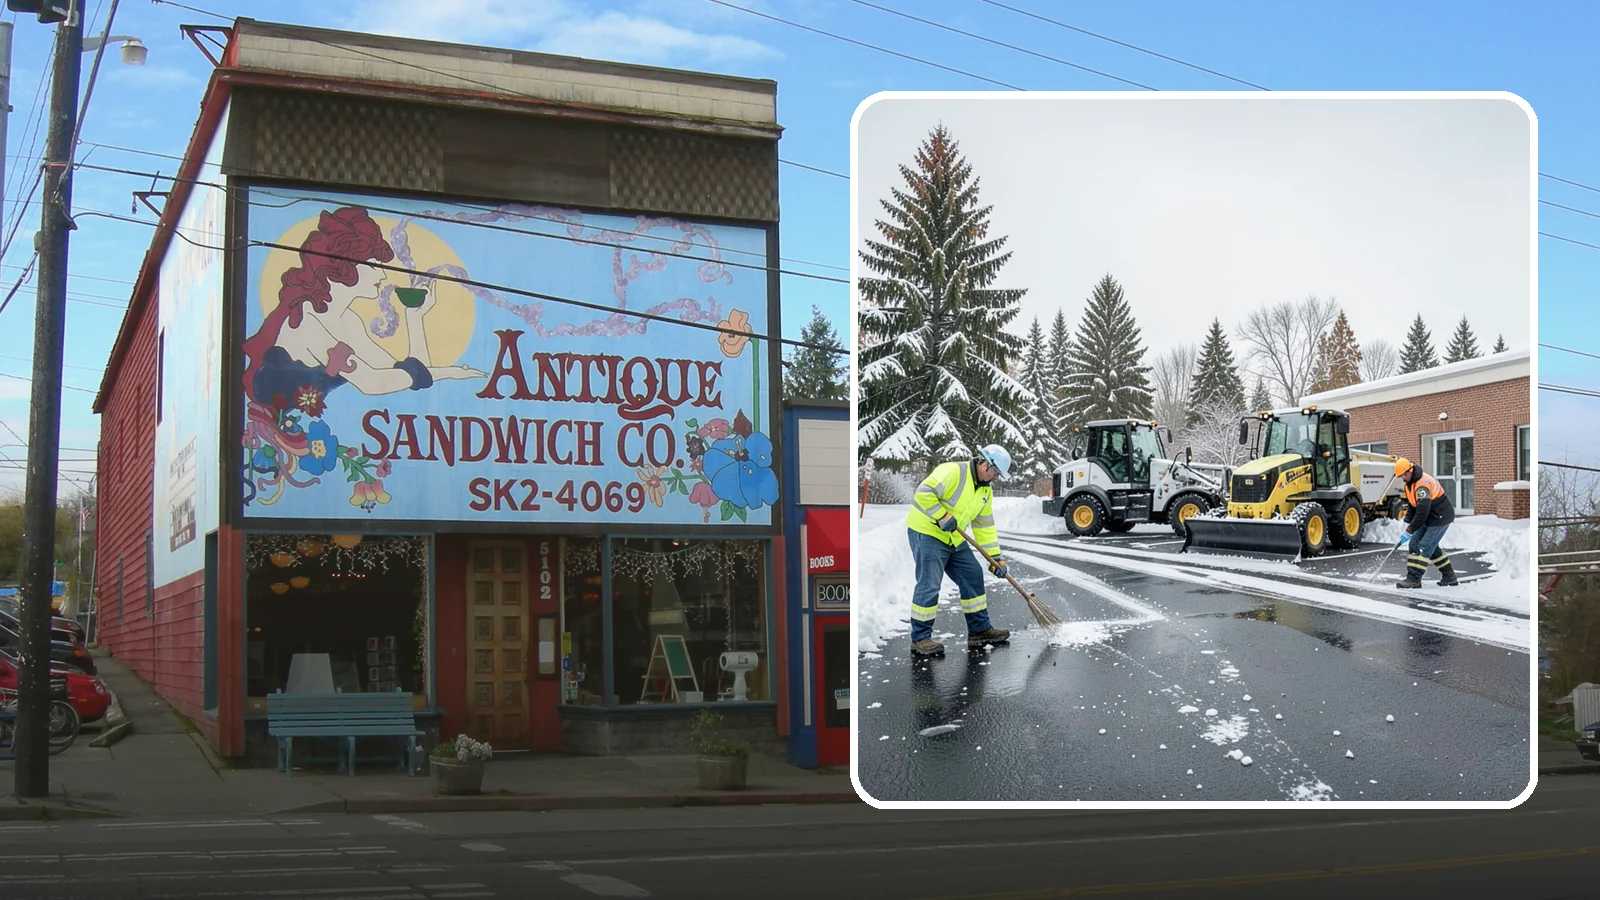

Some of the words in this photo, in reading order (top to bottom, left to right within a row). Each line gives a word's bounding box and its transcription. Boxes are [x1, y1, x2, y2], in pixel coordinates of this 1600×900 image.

[475, 328, 724, 420] ANTIQUE
[360, 407, 605, 467] SANDWICH
[616, 420, 685, 469] CO.
[468, 477, 646, 513] SK2-4069
[540, 541, 552, 600] 5102
[809, 555, 835, 569] BOOKS
